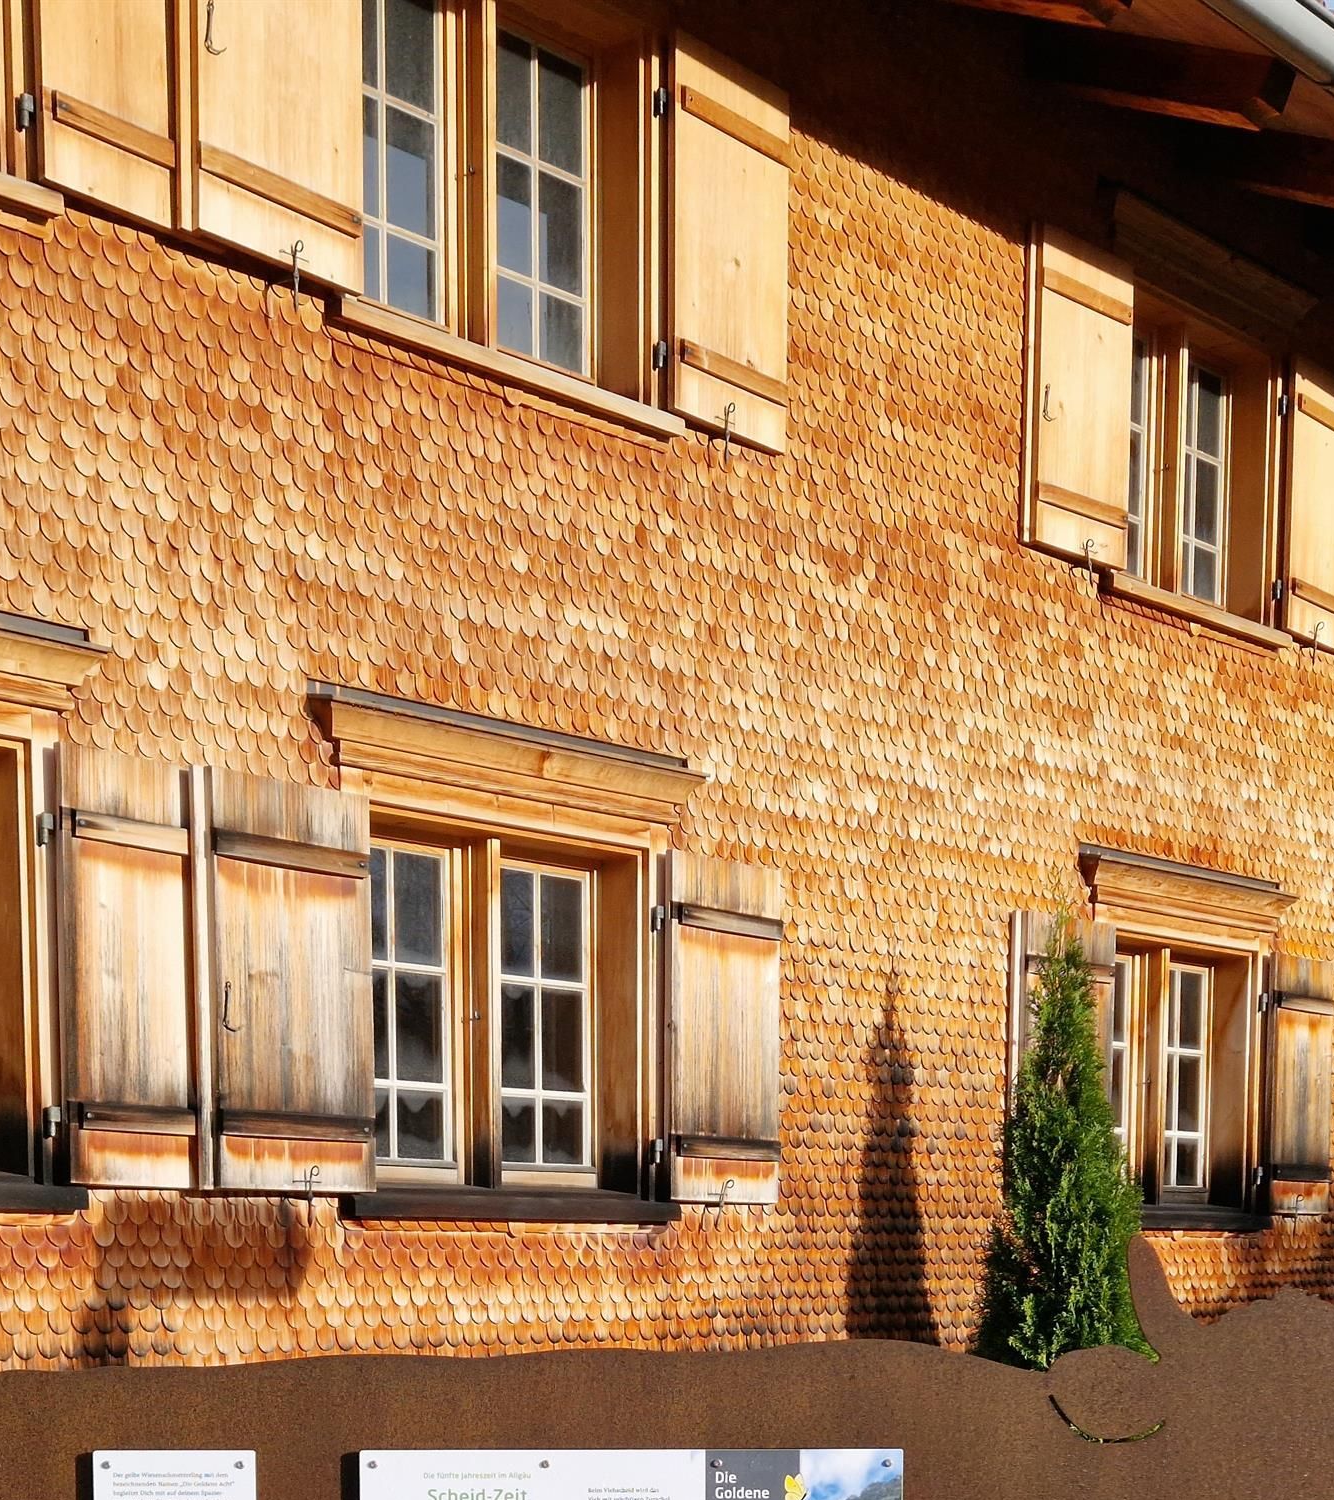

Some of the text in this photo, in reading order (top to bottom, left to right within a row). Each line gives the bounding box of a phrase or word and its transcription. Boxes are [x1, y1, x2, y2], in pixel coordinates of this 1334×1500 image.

[461, 1472, 496, 1480] Jahreszeit
[509, 1472, 531, 1480] Allgäu
[715, 1471, 736, 1483] Die
[715, 1487, 769, 1499] Goldene
